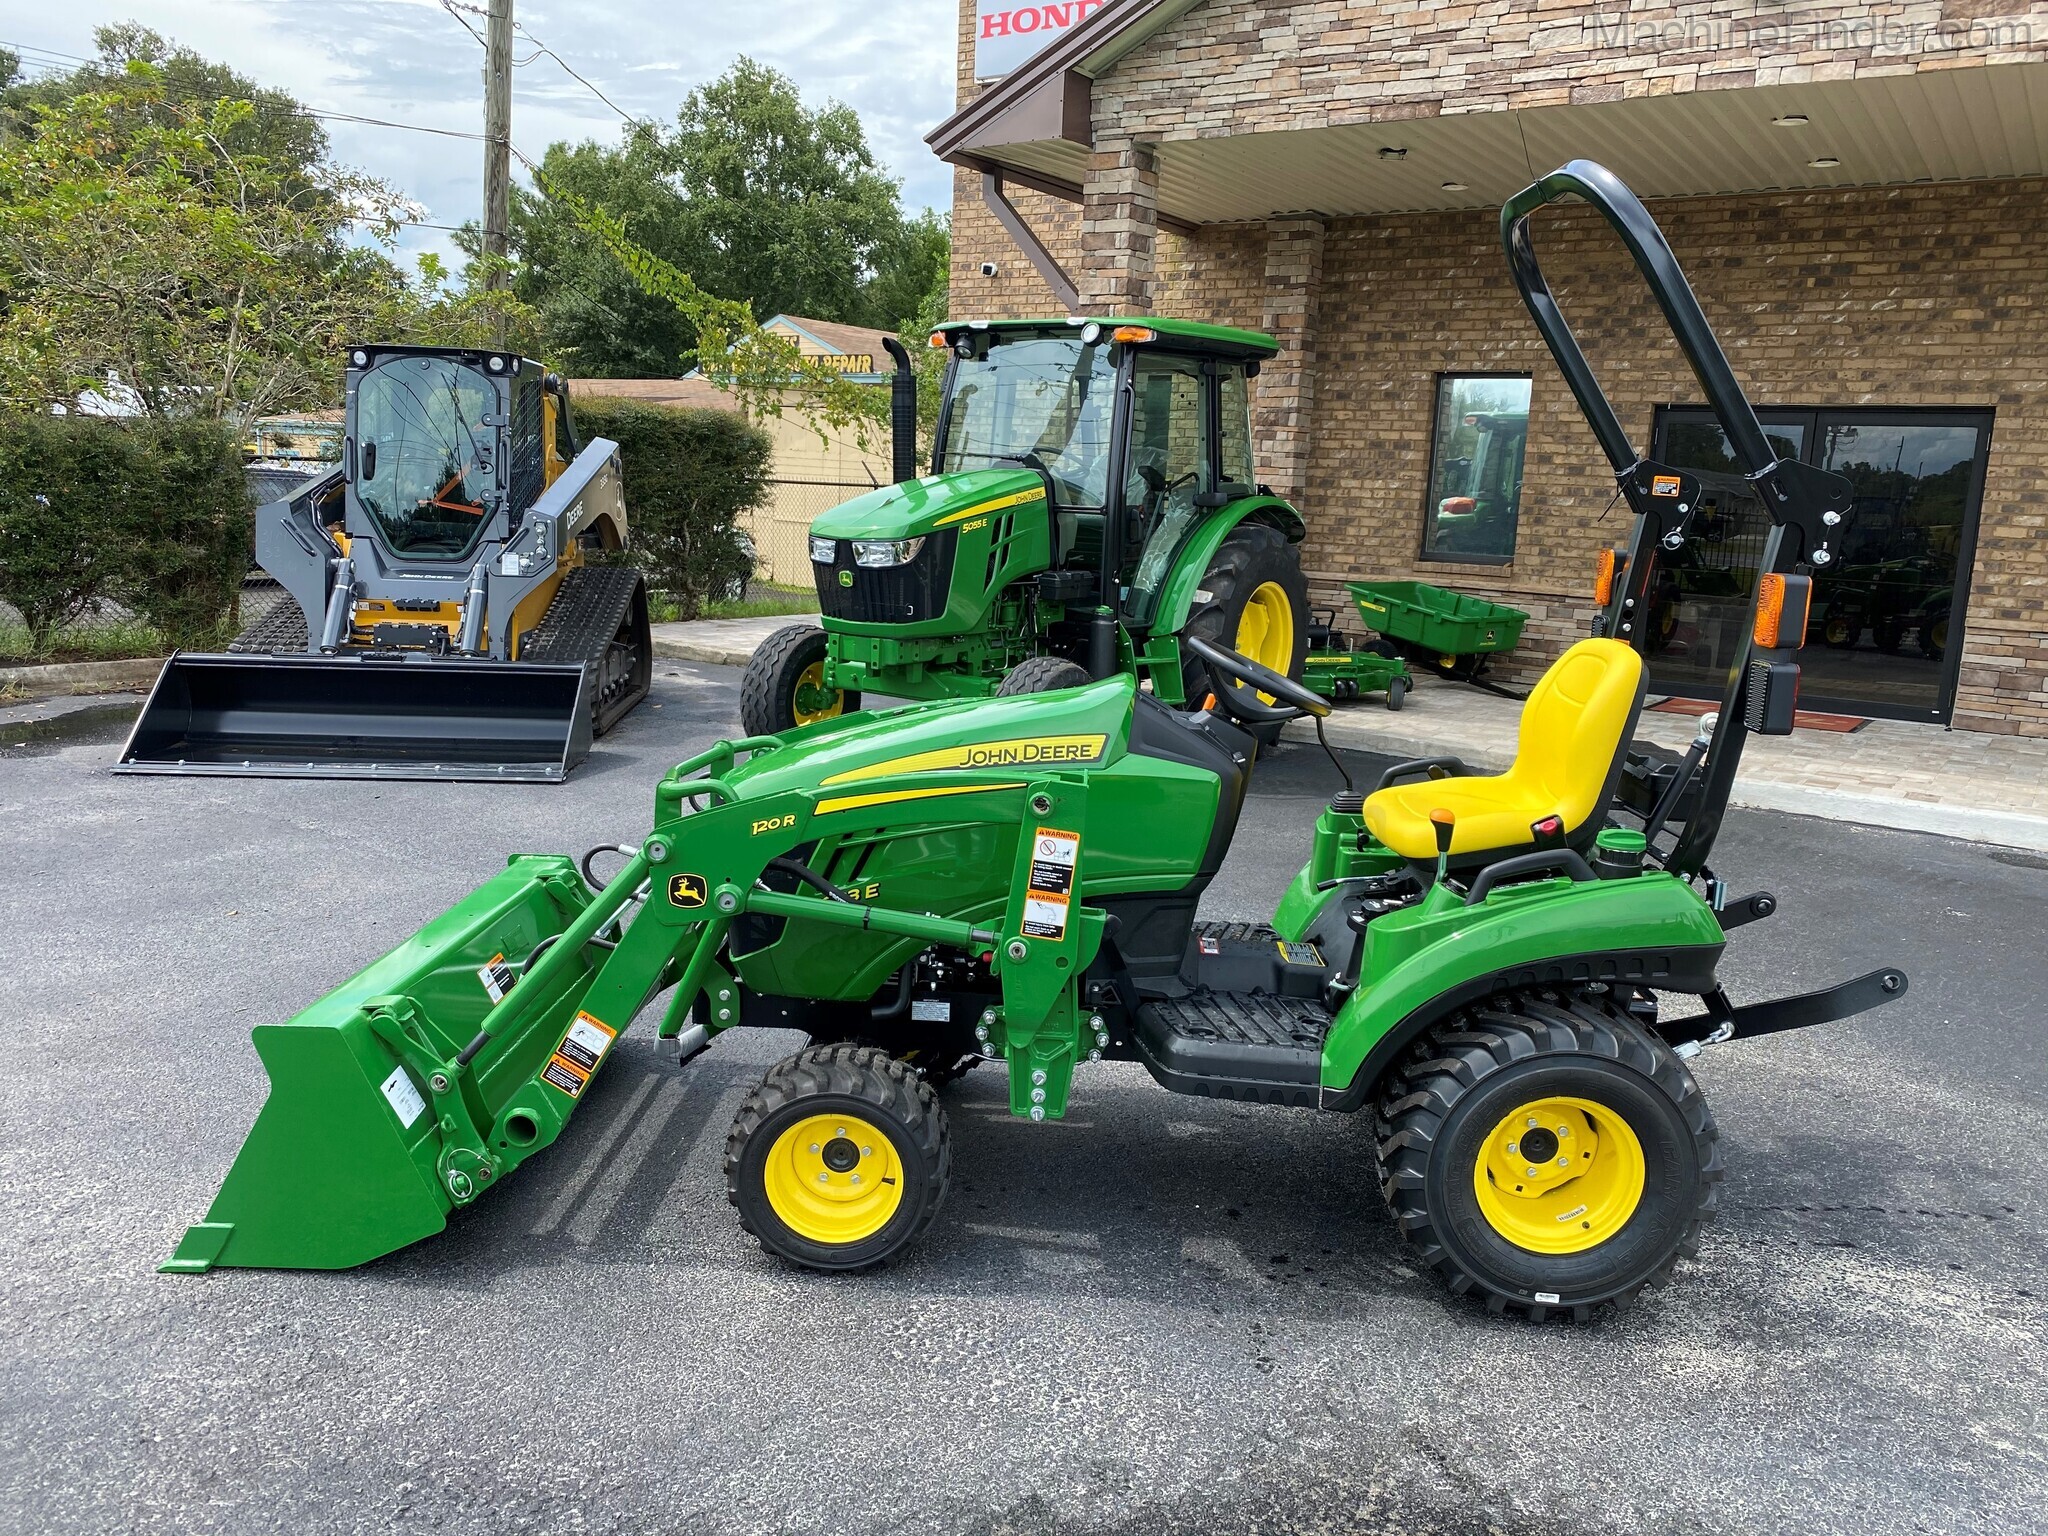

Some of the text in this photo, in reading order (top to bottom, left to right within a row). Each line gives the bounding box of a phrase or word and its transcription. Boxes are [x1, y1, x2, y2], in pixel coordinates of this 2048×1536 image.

[567, 500, 583, 530] DEERE
[960, 744, 1093, 767] JOHN DEERE
[752, 815, 796, 835] 120 R
[1045, 830, 1077, 840] WARNING
[1034, 894, 1067, 904] WARNING
[588, 1017, 612, 1035] WARNING
[561, 1061, 585, 1078] WARNING
